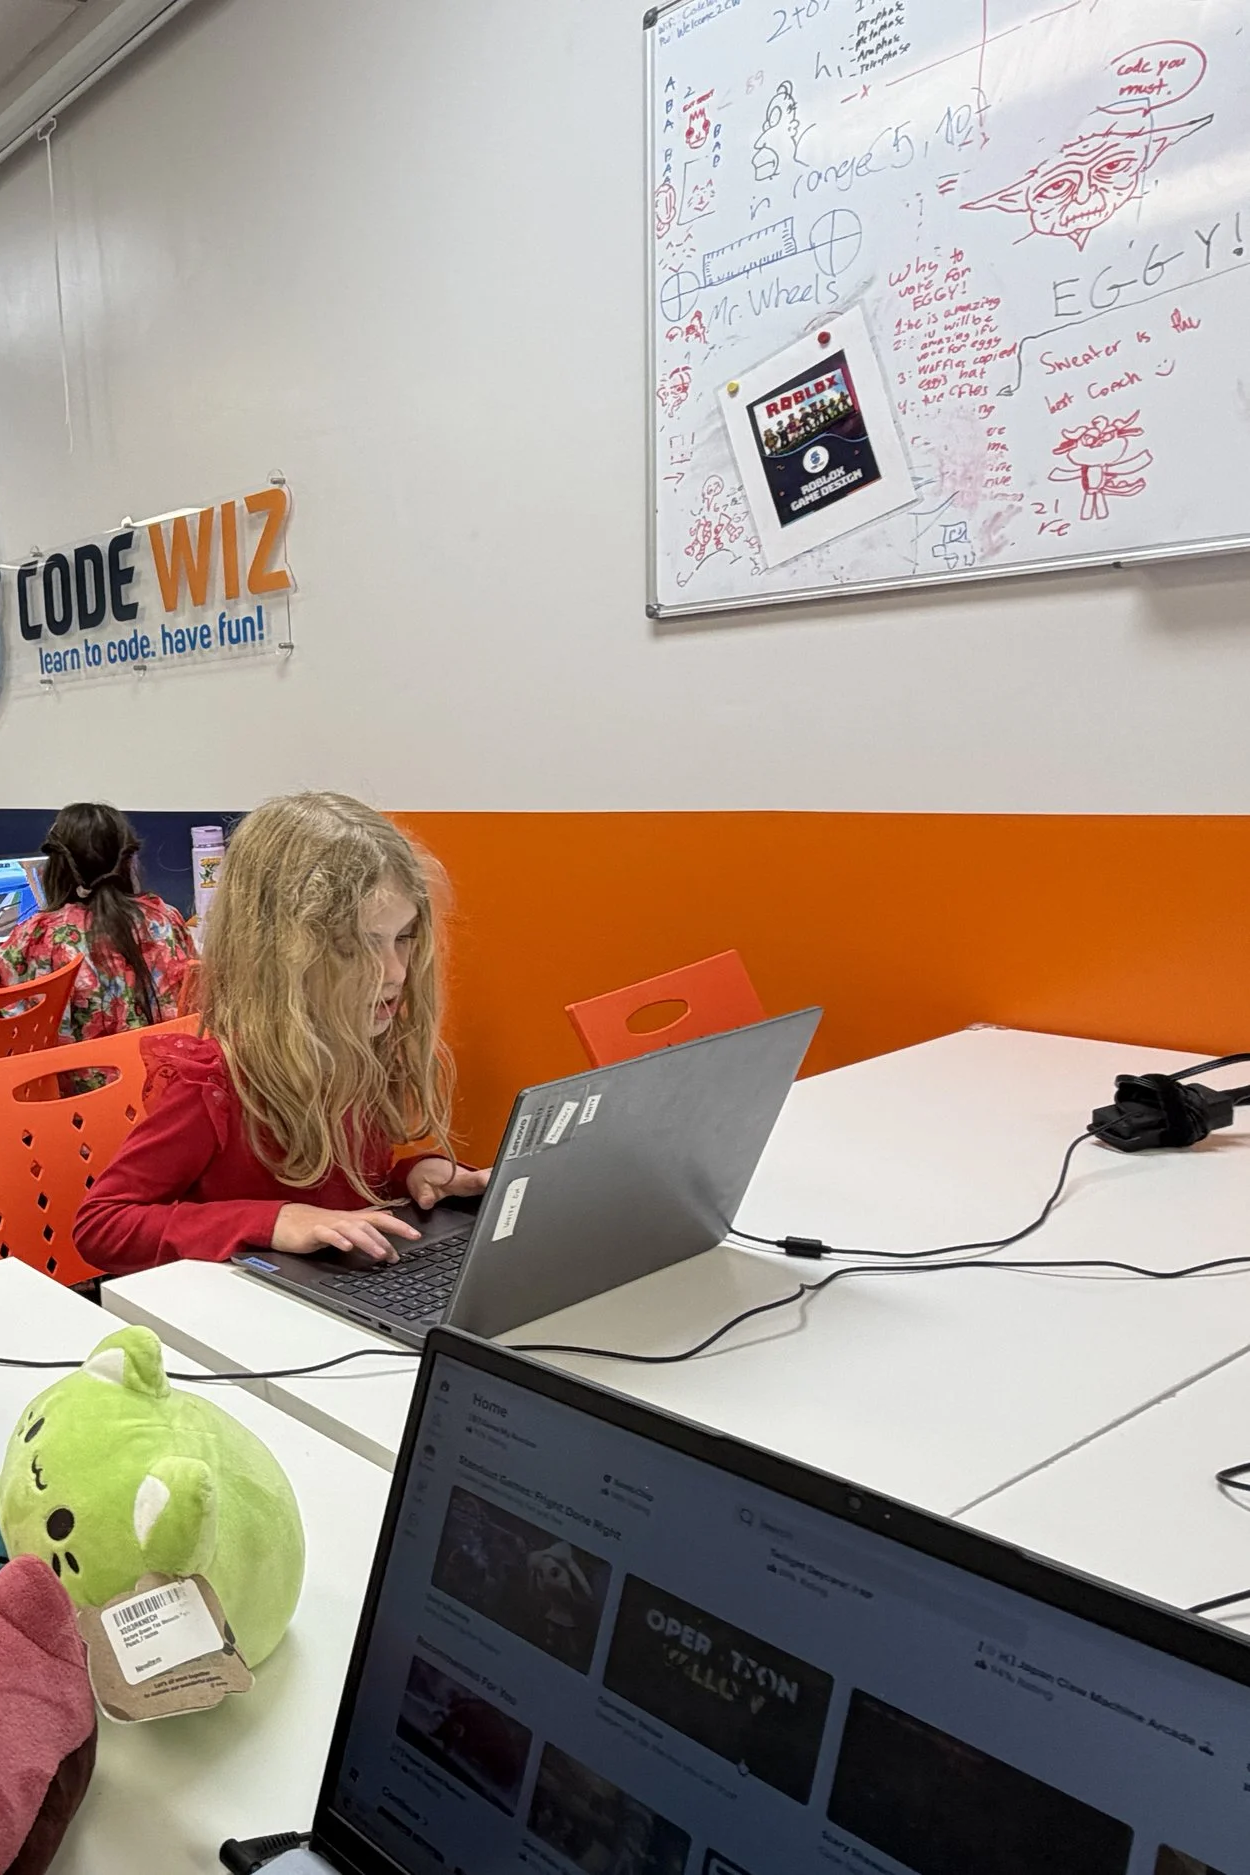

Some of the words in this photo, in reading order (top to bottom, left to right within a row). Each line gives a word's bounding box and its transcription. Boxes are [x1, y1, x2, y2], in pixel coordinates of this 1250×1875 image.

[764, 373, 839, 419] ROBLOX
[789, 489, 822, 512] GAME
[820, 468, 864, 500] DESIGN
[799, 465, 847, 495] ROBLOX
[17, 529, 140, 642] CODE
[146, 487, 292, 614] WIZ
[39, 646, 81, 675] learn
[83, 639, 103, 667] to
[161, 623, 212, 658] have
[218, 604, 266, 647] fun!
[509, 1118, 528, 1157] Lenovo
[472, 1392, 509, 1419] Home
